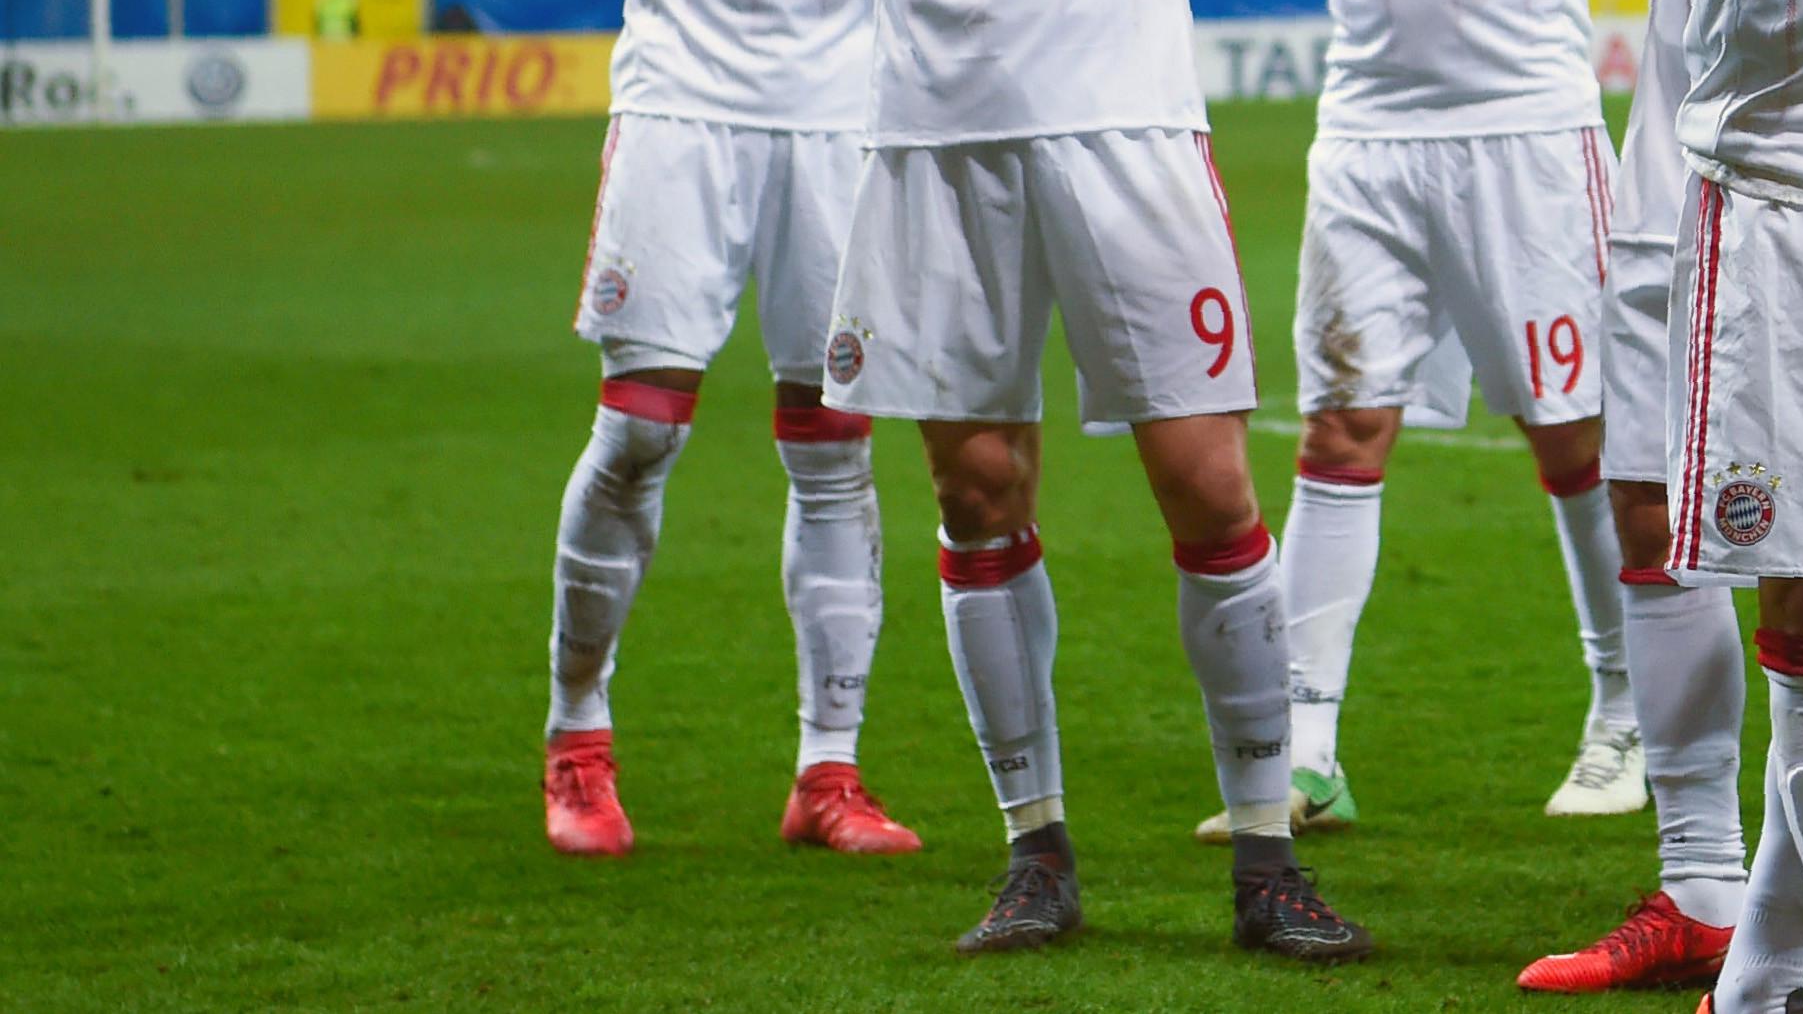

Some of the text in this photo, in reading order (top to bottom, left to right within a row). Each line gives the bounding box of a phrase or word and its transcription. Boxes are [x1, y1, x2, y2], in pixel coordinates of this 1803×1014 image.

[375, 44, 557, 106] PRIO
[1190, 287, 1234, 379] 9
[1525, 314, 1584, 400] 19
[1729, 484, 1770, 510] BAYERN
